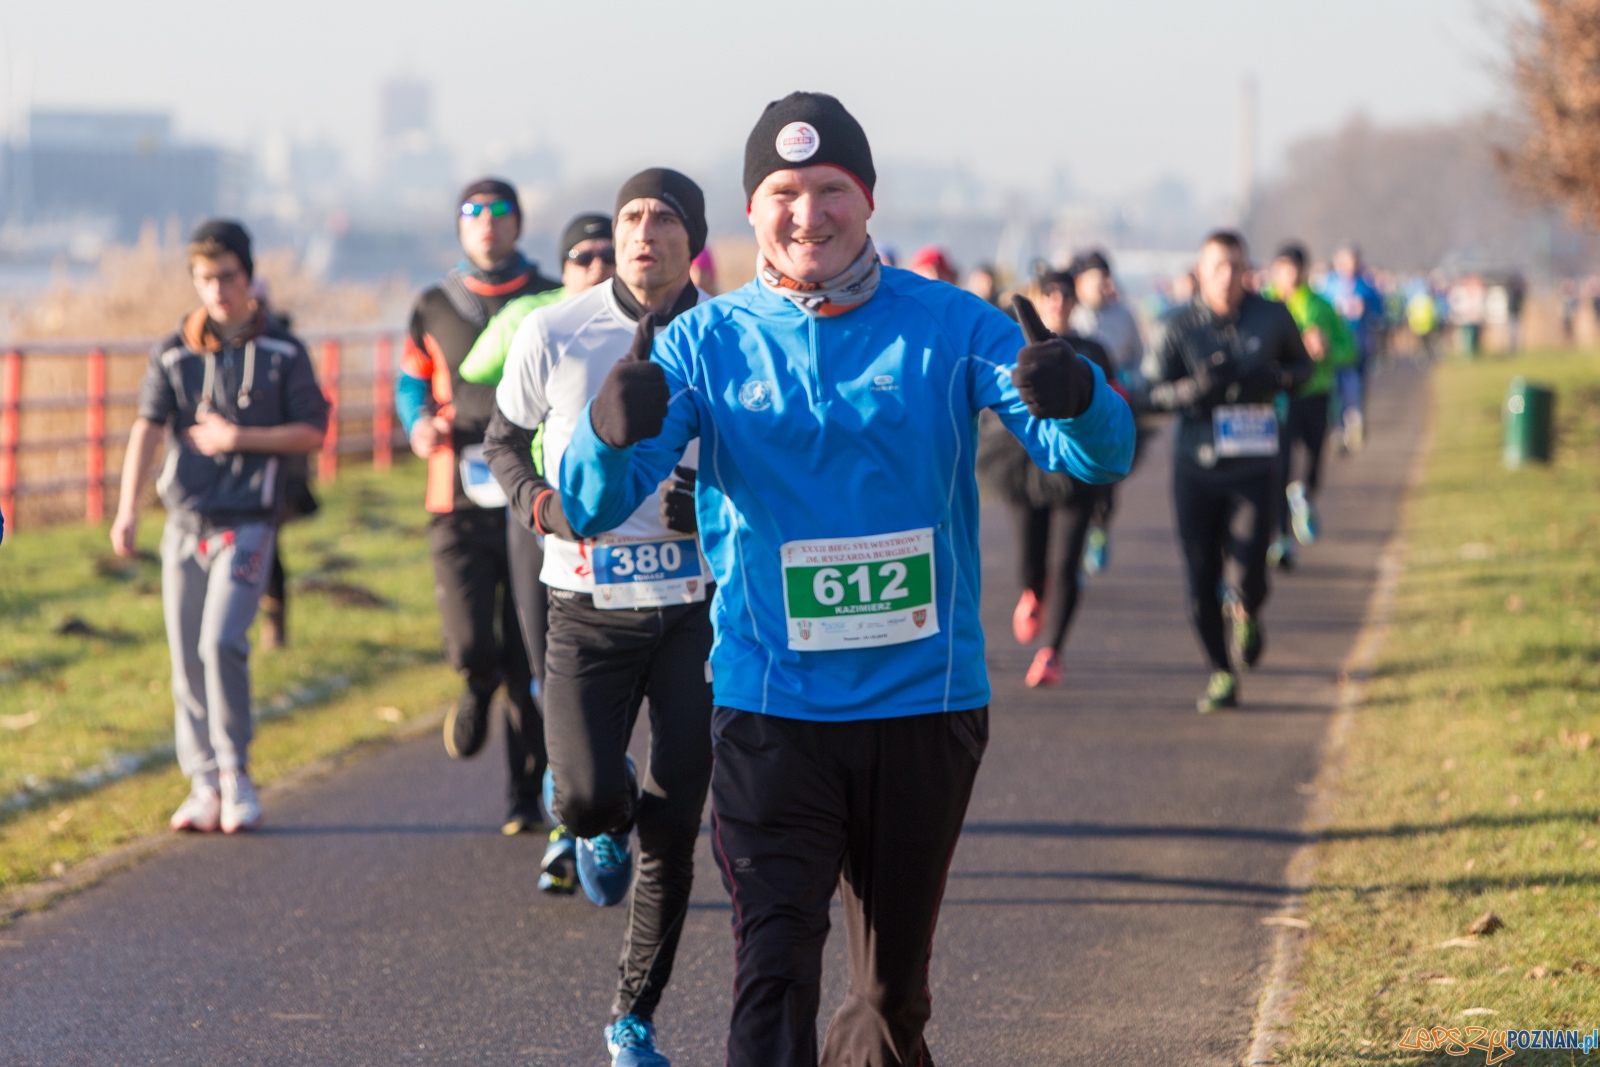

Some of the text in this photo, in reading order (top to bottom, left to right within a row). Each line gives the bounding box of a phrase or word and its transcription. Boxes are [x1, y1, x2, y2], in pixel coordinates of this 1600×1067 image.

[828, 543, 851, 552] BIEG
[611, 542, 681, 576] 380
[821, 553, 872, 564] RYSZARDA
[633, 572, 665, 582] TOMASZ
[813, 561, 909, 606] 612
[835, 602, 892, 614] KAZIMIERZ
